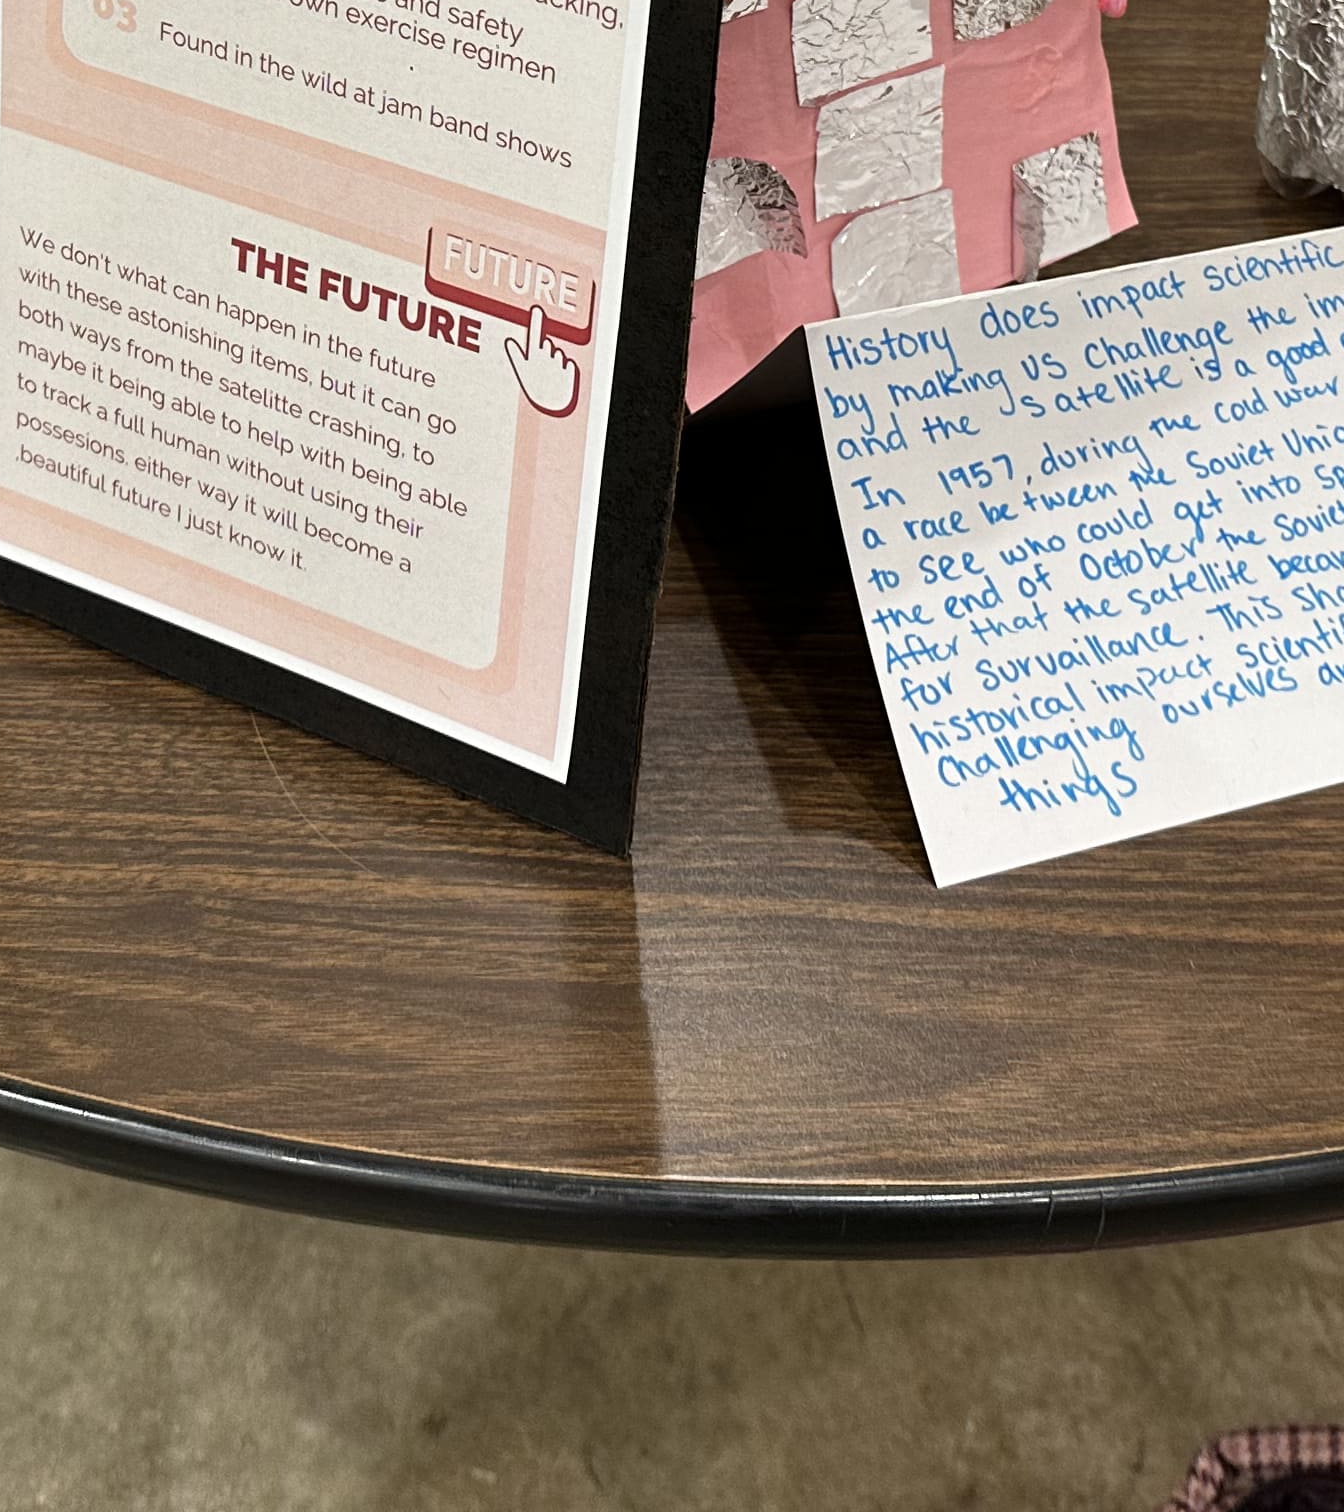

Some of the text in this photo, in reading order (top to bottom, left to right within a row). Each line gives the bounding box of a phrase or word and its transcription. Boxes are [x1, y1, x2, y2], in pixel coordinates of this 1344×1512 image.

[345, 6, 447, 51] exercise
[452, 37, 556, 85] regimen
[446, 5, 525, 47] safety
[159, 20, 572, 169] Found in the wild at jam band shows
[19, 225, 436, 389] We don't what can happen in the future
[230, 236, 483, 354] THE FUTURE
[443, 232, 580, 314] FUTURE
[827, 326, 956, 369] History
[980, 302, 1058, 339] does
[1078, 270, 1185, 318] impact
[837, 413, 907, 461] and
[922, 417, 981, 445] the
[1191, 356, 1222, 381] is
[1235, 358, 1255, 376] a
[1267, 329, 1331, 384] good
[910, 682, 1086, 755] historical
[1096, 654, 1213, 704] impact
[1000, 761, 1138, 816] things
